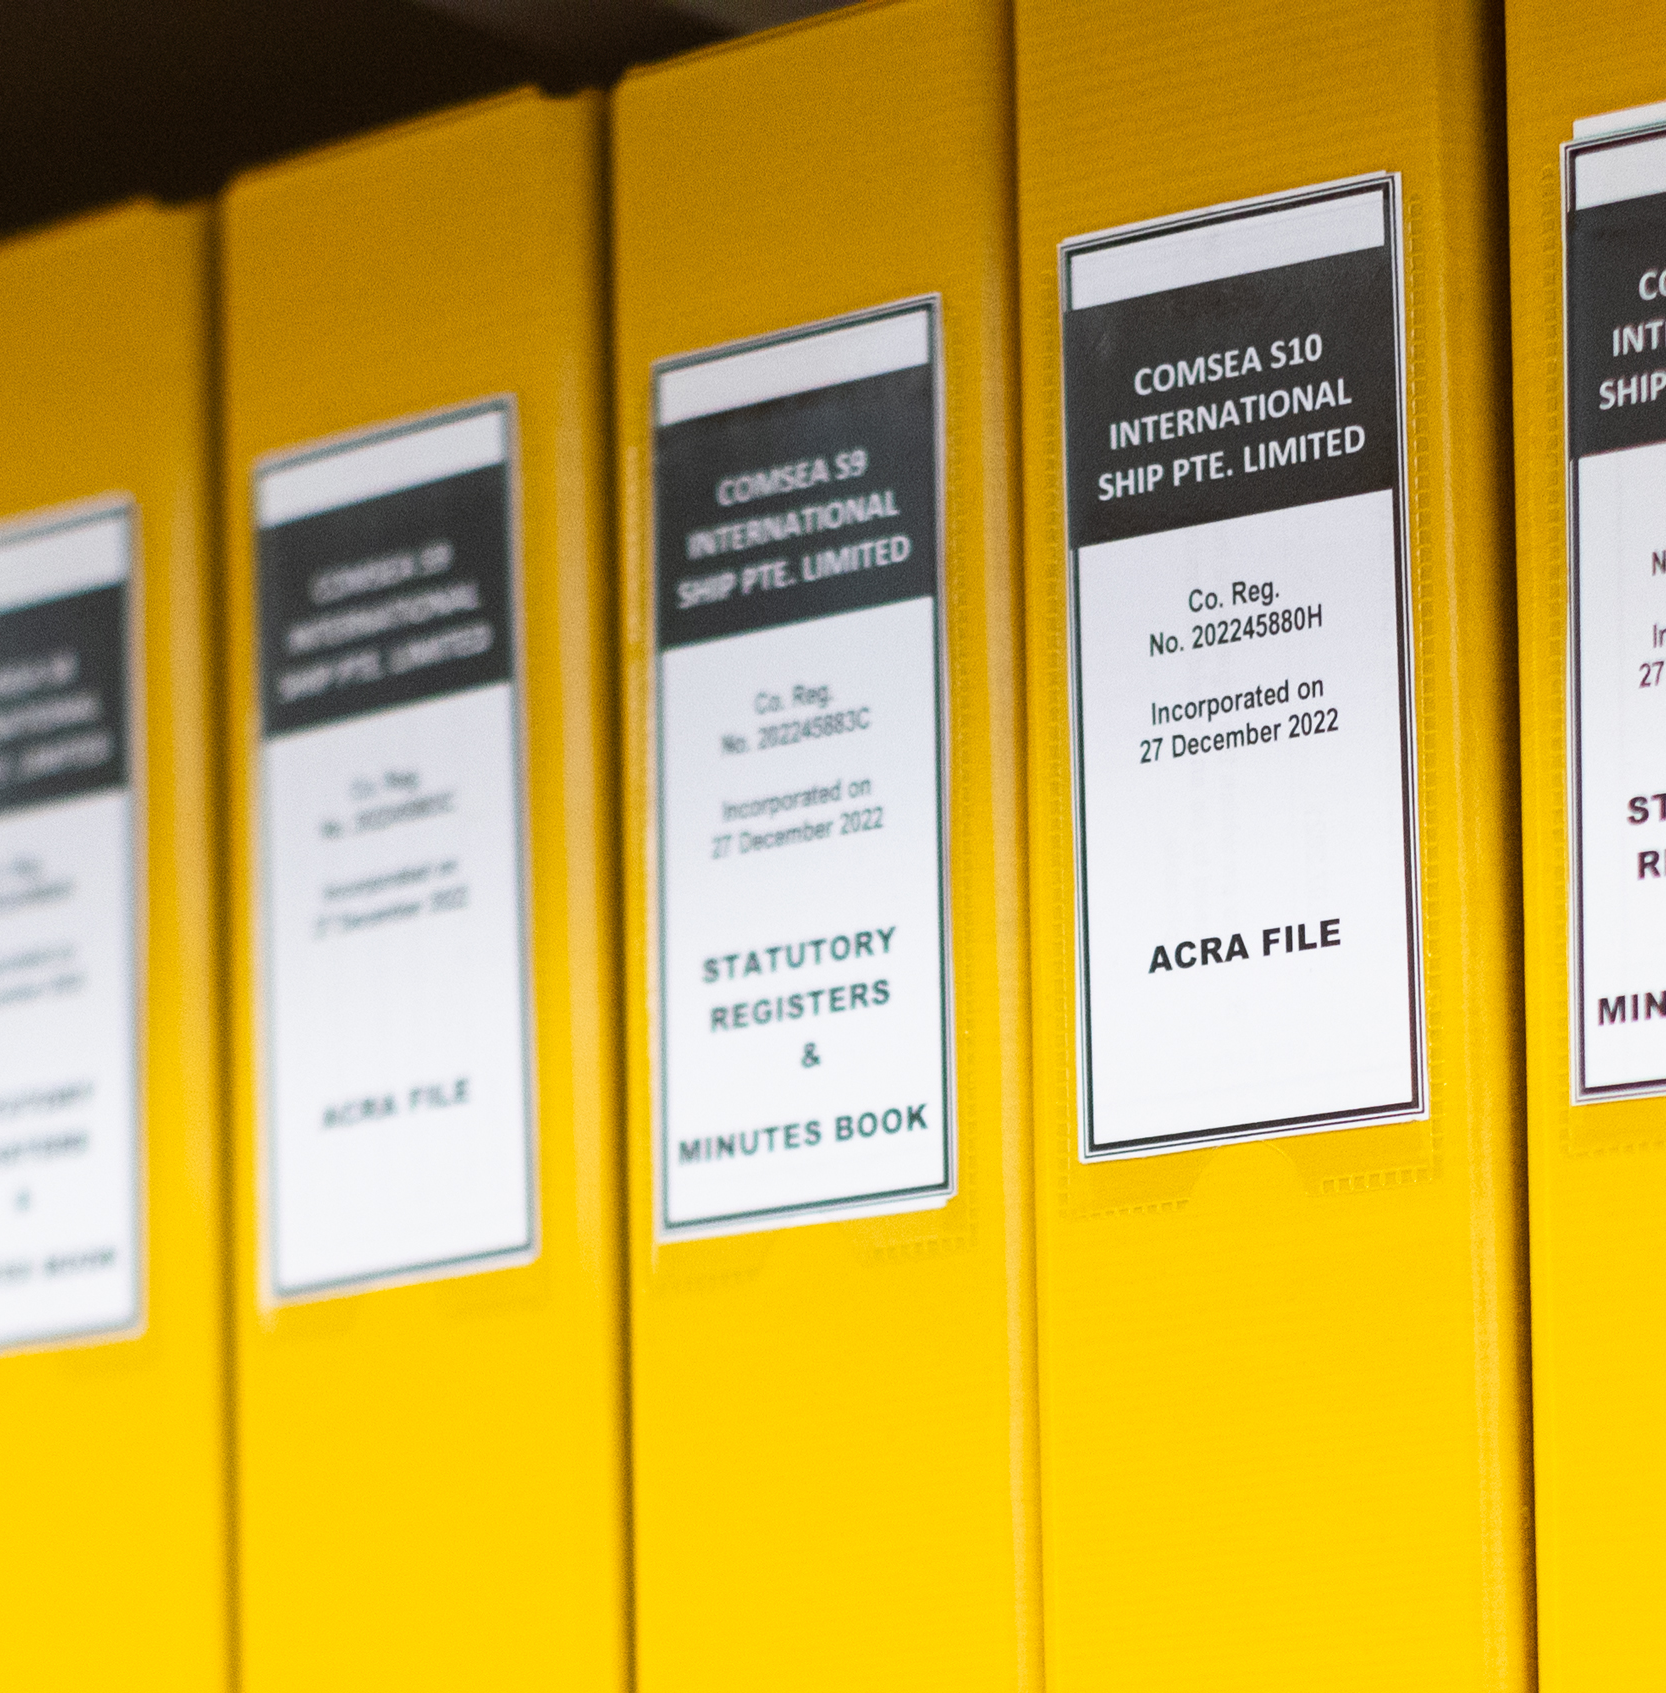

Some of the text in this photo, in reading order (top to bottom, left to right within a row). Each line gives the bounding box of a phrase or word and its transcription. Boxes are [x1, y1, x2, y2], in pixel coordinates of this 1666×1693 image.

[1133, 333, 1324, 397] COMSEA S10
[1109, 378, 1352, 450] INTERNATIONAL
[716, 447, 869, 507] COMSEA S9
[1097, 425, 1366, 502] SHIP PTE. LIMITED
[686, 489, 900, 559] INTERNATIONAL
[677, 534, 913, 609] SHIP PTE. LIMITED
[1188, 579, 1280, 613] Co. Reg.
[1149, 604, 1323, 657] No. 202245880H
[1151, 678, 1325, 726] Incorporated on
[1638, 660, 1665, 688] 27
[1139, 708, 1339, 764] 27 December 2022
[722, 778, 871, 822] Incorporated on
[711, 805, 884, 860] 27 December 2022
[702, 926, 896, 984] STATUTORY
[1148, 918, 1342, 974] ACRA FILE
[710, 978, 891, 1033] REGISTERS
[800, 1041, 821, 1069] &
[678, 1103, 928, 1166] MINUTES BOOK
